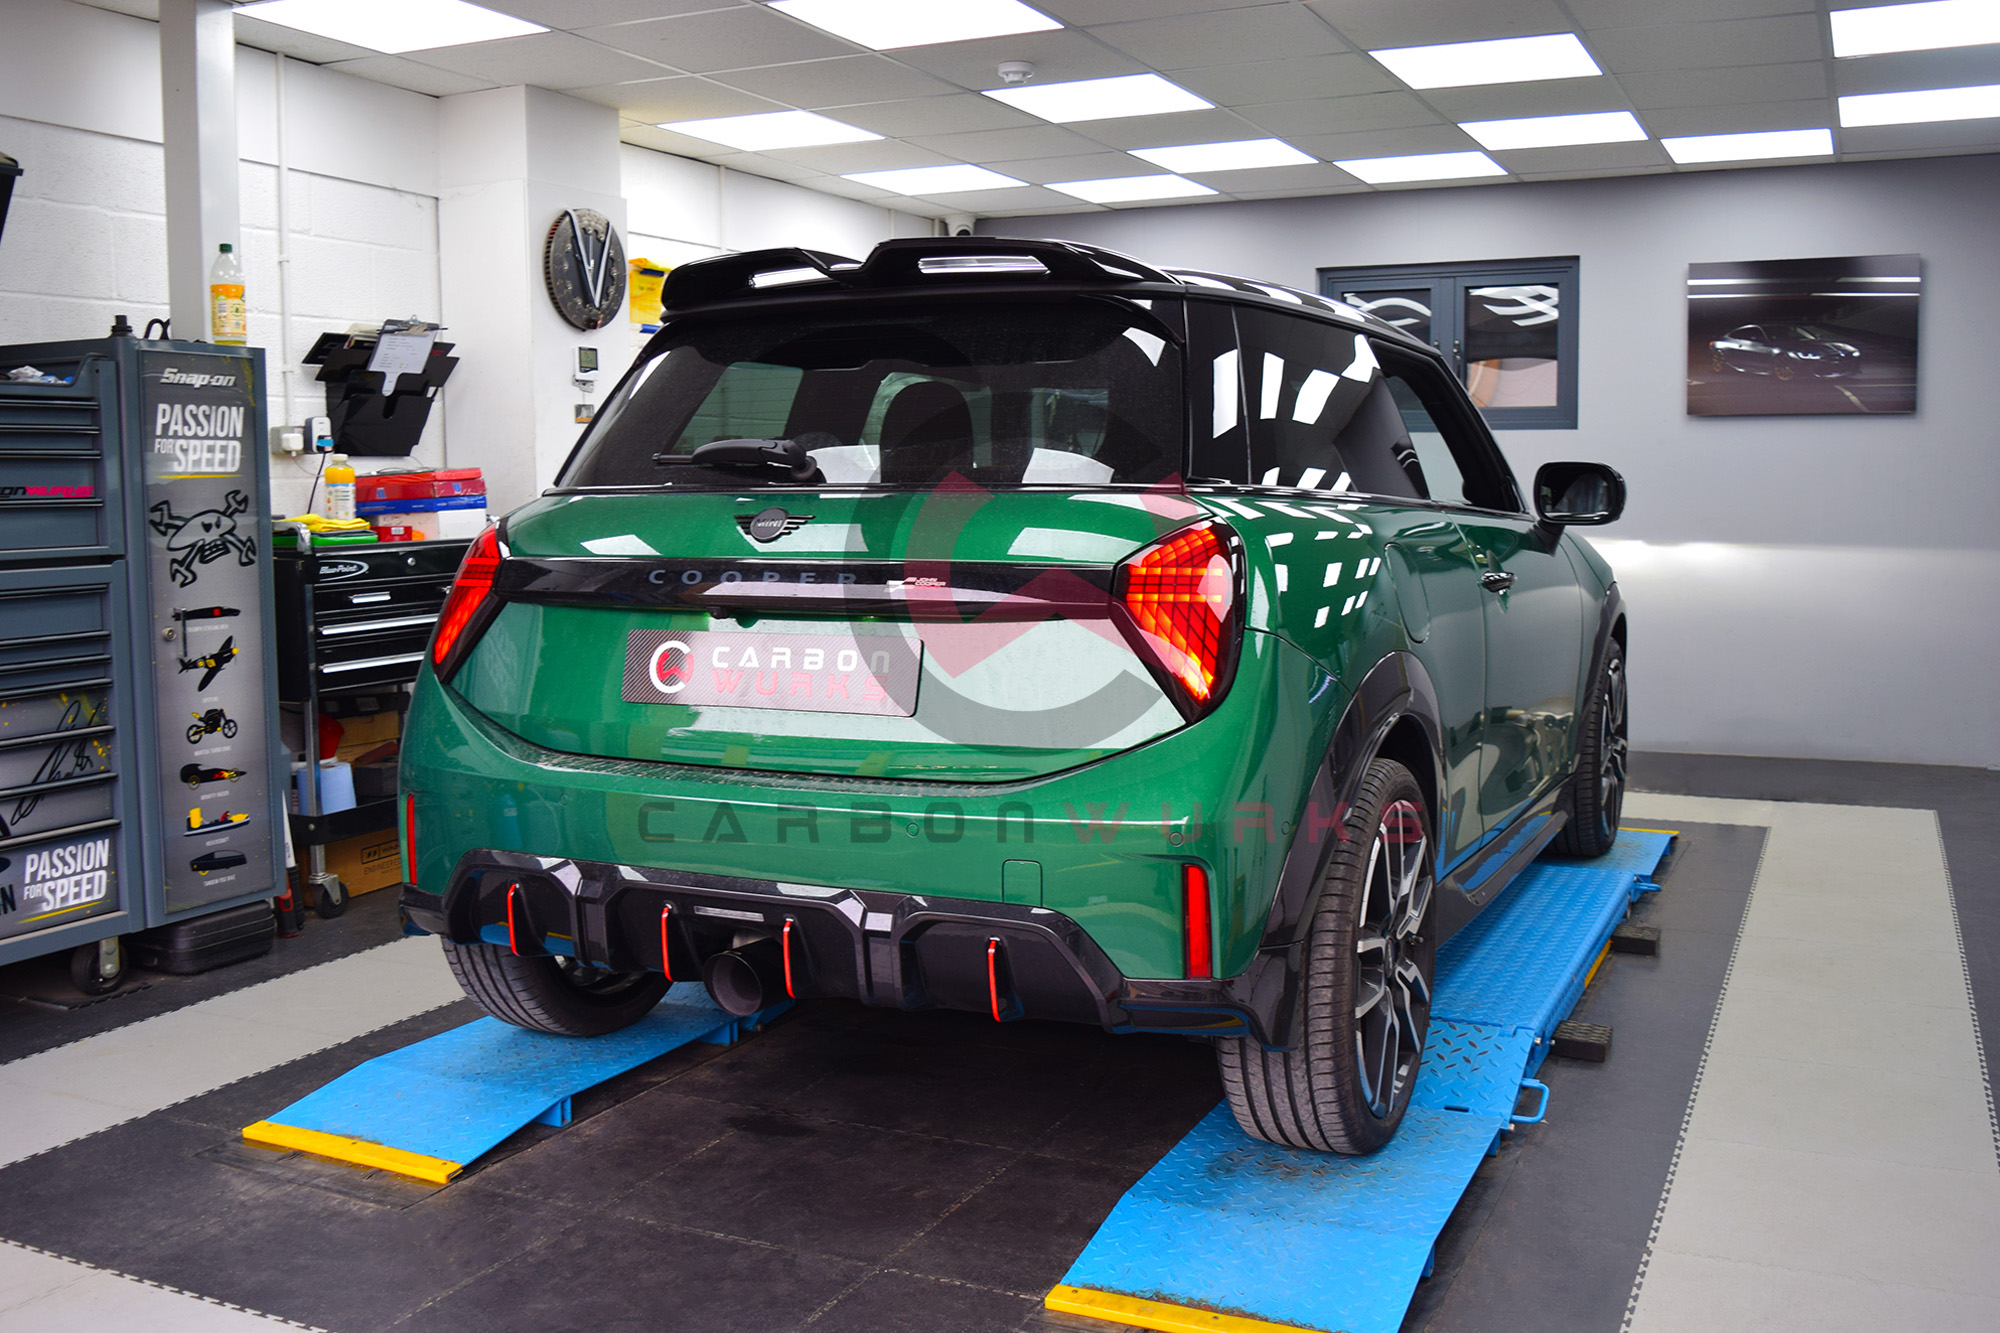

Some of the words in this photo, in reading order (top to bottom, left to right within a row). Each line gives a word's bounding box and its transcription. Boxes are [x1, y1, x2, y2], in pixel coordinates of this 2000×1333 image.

[160, 367, 236, 389] Snap-on
[155, 403, 245, 438] PASSION
[155, 438, 175, 454] FOR
[173, 439, 242, 473] SPEED
[648, 569, 857, 585] COOPER
[711, 669, 889, 701] WURKS
[24, 838, 110, 884] PASSION
[23, 883, 43, 900] FOR
[41, 869, 108, 912] SPEED
